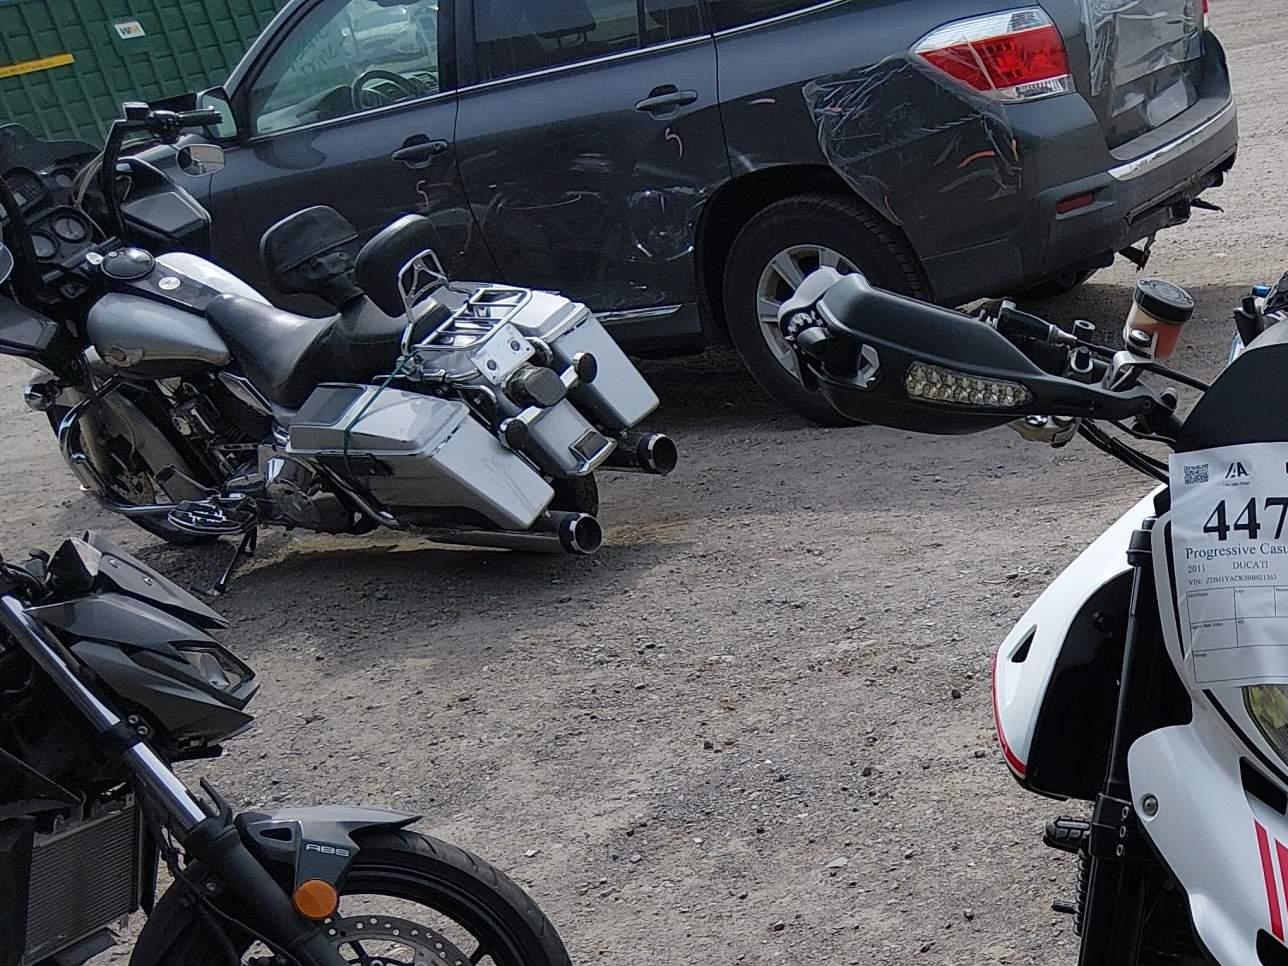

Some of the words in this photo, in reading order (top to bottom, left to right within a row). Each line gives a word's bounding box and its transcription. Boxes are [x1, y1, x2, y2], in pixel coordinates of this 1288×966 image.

[1186, 545, 1257, 561] Progressive
[1232, 560, 1269, 569] DUCATI
[306, 844, 350, 857] ABS
